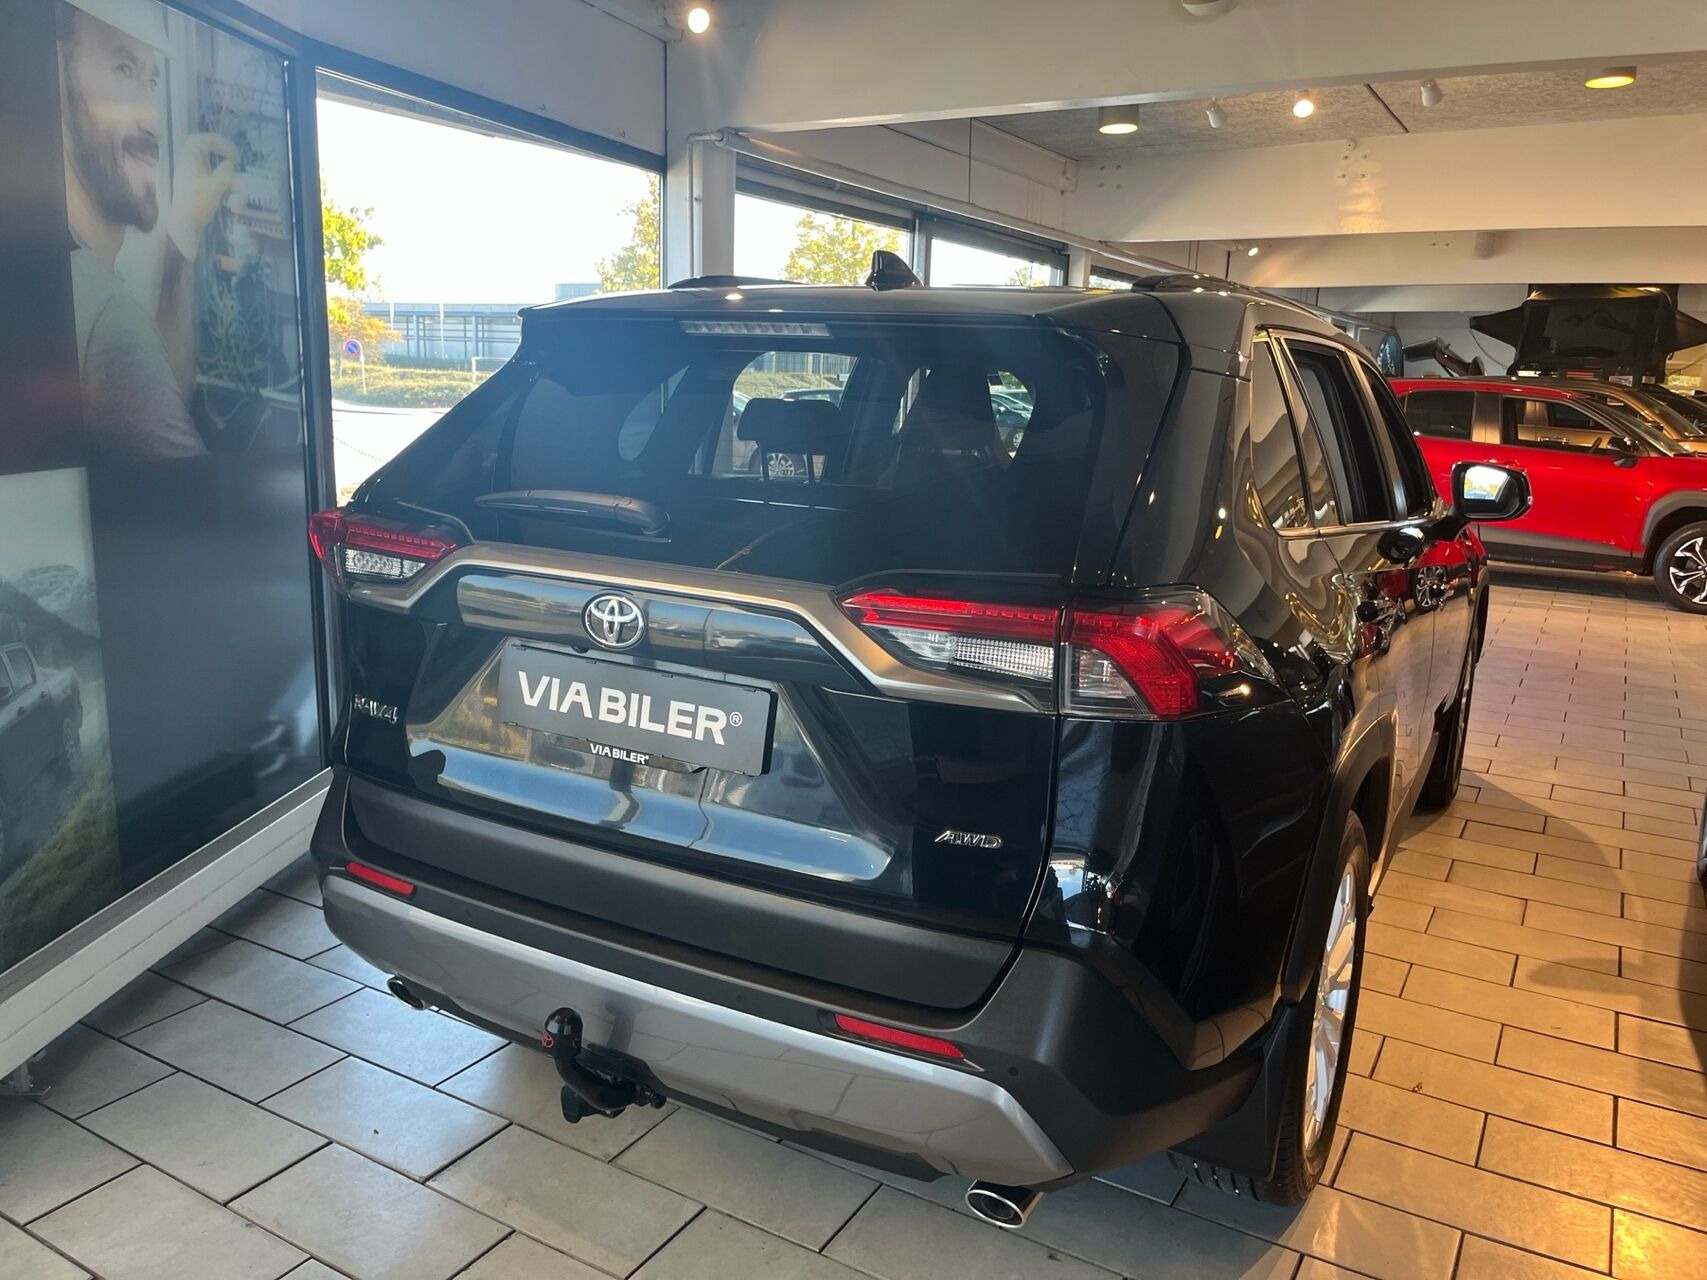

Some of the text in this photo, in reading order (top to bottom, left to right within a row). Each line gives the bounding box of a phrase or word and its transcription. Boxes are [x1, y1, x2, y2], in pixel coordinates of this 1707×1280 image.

[518, 671, 592, 719] VIA
[354, 694, 398, 724] RAV4
[590, 742, 611, 757] VIA
[934, 830, 1002, 849] AWD
